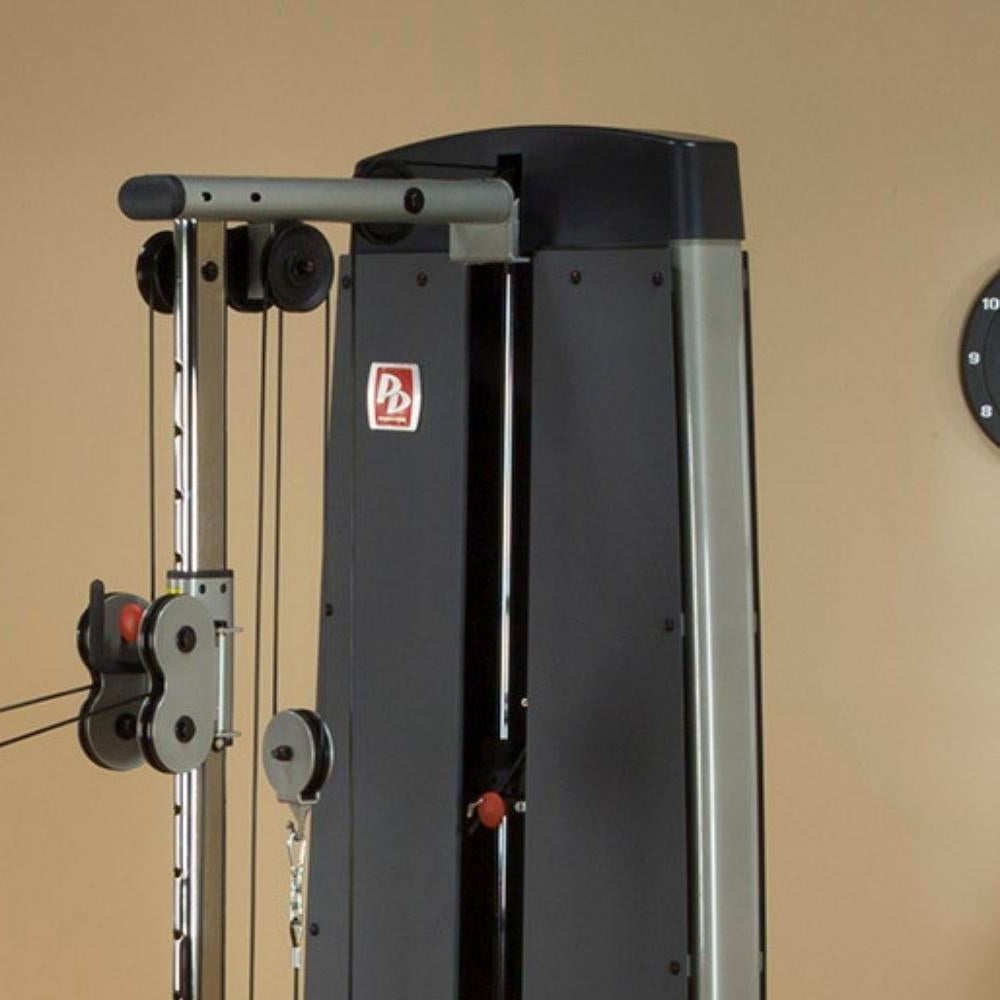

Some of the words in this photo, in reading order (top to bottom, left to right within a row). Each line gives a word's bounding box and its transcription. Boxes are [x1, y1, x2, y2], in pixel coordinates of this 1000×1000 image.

[982, 297, 1000, 311] 10
[968, 351, 981, 365] 9
[980, 404, 993, 419] 8
